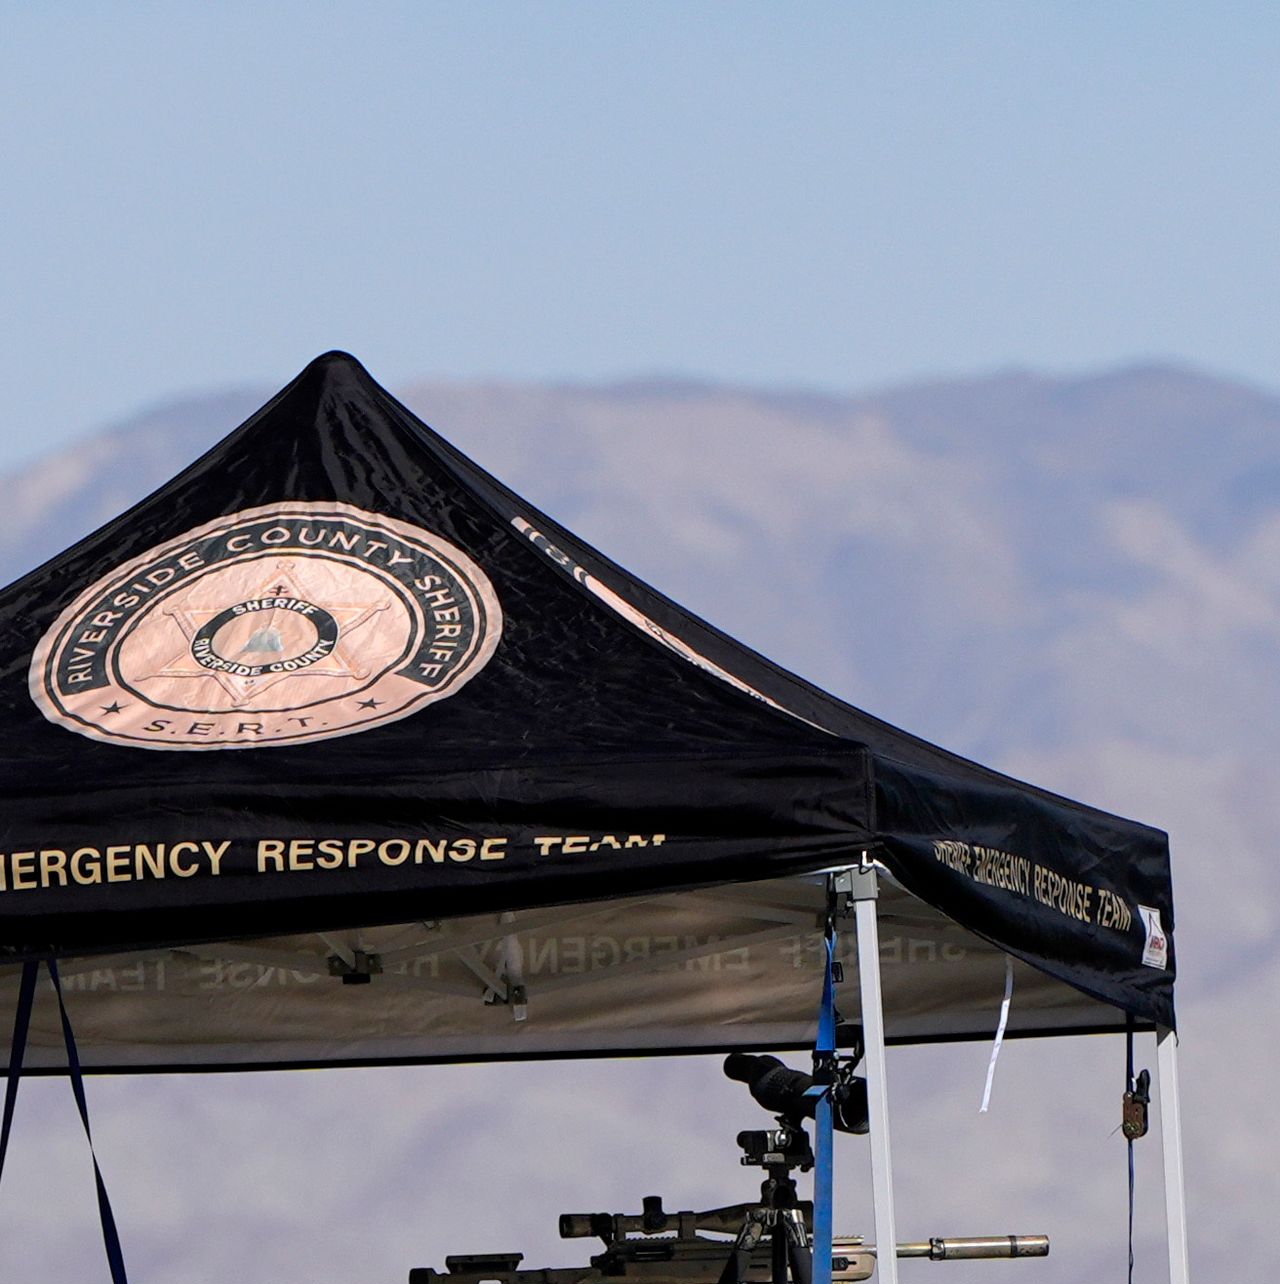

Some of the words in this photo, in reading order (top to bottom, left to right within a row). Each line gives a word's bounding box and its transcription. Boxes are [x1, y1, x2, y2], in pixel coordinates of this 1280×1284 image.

[67, 551, 206, 685] RIVERSIDE
[226, 526, 414, 568] COUNTY
[414, 574, 462, 679] SHERIFF
[231, 598, 320, 616] SHERIFF
[194, 637, 263, 677] RIVERSIDE
[270, 638, 335, 673] COUNTY
[142, 715, 329, 738] S.E.R.T.
[256, 836, 508, 874] RESPONSE
[973, 846, 1031, 897] EMERGENCY
[1034, 863, 1093, 924] RESPONSE
[1097, 888, 1132, 933] TEAM
